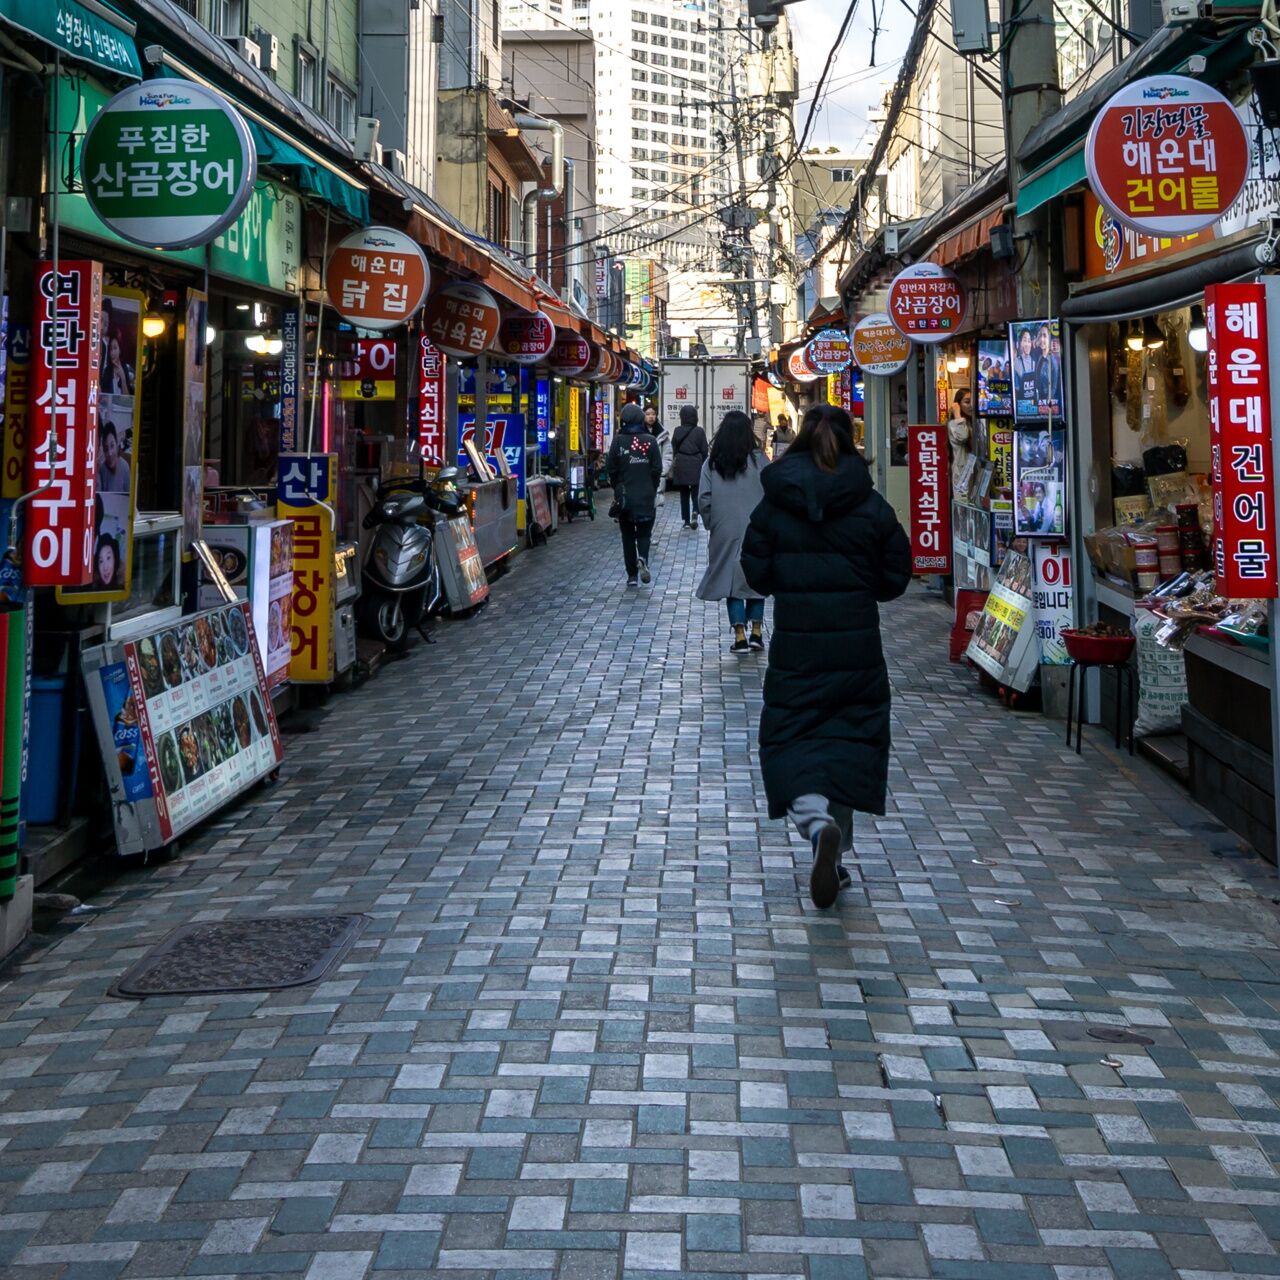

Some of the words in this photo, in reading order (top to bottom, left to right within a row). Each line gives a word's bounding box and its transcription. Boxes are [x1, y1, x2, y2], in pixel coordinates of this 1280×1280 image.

[56, 9, 93, 52] 소영장식
[94, 34, 134, 69] 인테리어
[117, 123, 210, 157] 푸짐한
[1121, 105, 1212, 139] 기장명물
[1122, 138, 1217, 175] 해운대
[91, 158, 235, 198] 산곰장어
[1126, 175, 1220, 213] 건어물
[350, 254, 406, 276] 해운대
[341, 278, 409, 313] 닭집
[445, 300, 485, 322] 해운대
[894, 294, 961, 316] 산곰장어
[39, 270, 86, 370] 연탄
[432, 317, 488, 351] 식육점
[420, 380, 440, 465] 석쇠구이
[31, 378, 78, 578] 석쇠구이
[916, 430, 942, 552] 연탄석쇠구이
[281, 461, 325, 670] 산곰장어
[114, 726, 139, 742] Cass
